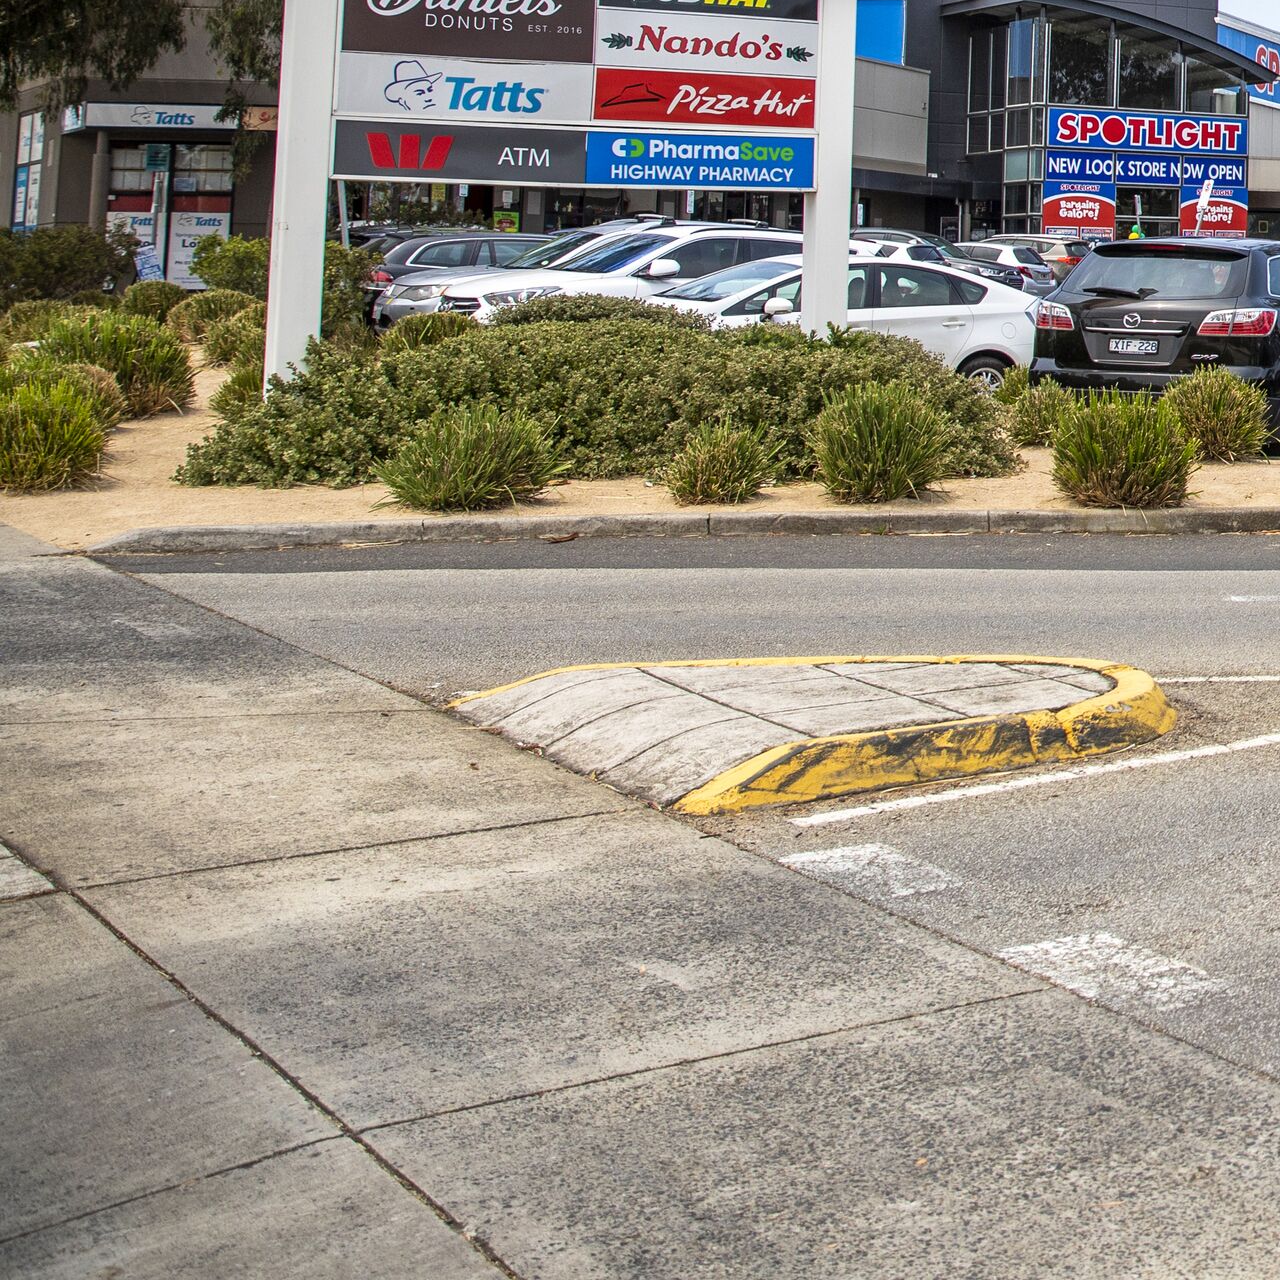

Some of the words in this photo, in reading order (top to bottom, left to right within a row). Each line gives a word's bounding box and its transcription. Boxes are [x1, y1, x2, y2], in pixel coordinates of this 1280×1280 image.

[425, 13, 514, 32] DONUTS
[557, 25, 582, 35] 2016
[634, 25, 784, 61] Nando's
[445, 76, 545, 113] Tatts
[666, 84, 750, 115] Pizza
[748, 89, 813, 117] Hut
[155, 111, 196, 125] Tatts
[1056, 112, 1242, 151] SPOTLIGHT
[498, 147, 550, 167] ATM
[650, 139, 794, 161] PharmaSave
[611, 164, 694, 180] HIGHWAY
[700, 166, 794, 182] PHARMACY
[1049, 157, 1081, 174] NEW
[1086, 158, 1124, 176] LOOK
[1128, 160, 1166, 178] STORE
[1171, 162, 1204, 179] NOW
[1209, 164, 1242, 181] OPEN
[1060, 184, 1100, 192] SPOTLIGHT
[1196, 189, 1234, 197] STLIGHT
[1059, 208, 1100, 220] Galore!
[1060, 200, 1100, 210] Bargains
[130, 216, 153, 226] Tatt
[194, 216, 223, 227] Tatts
